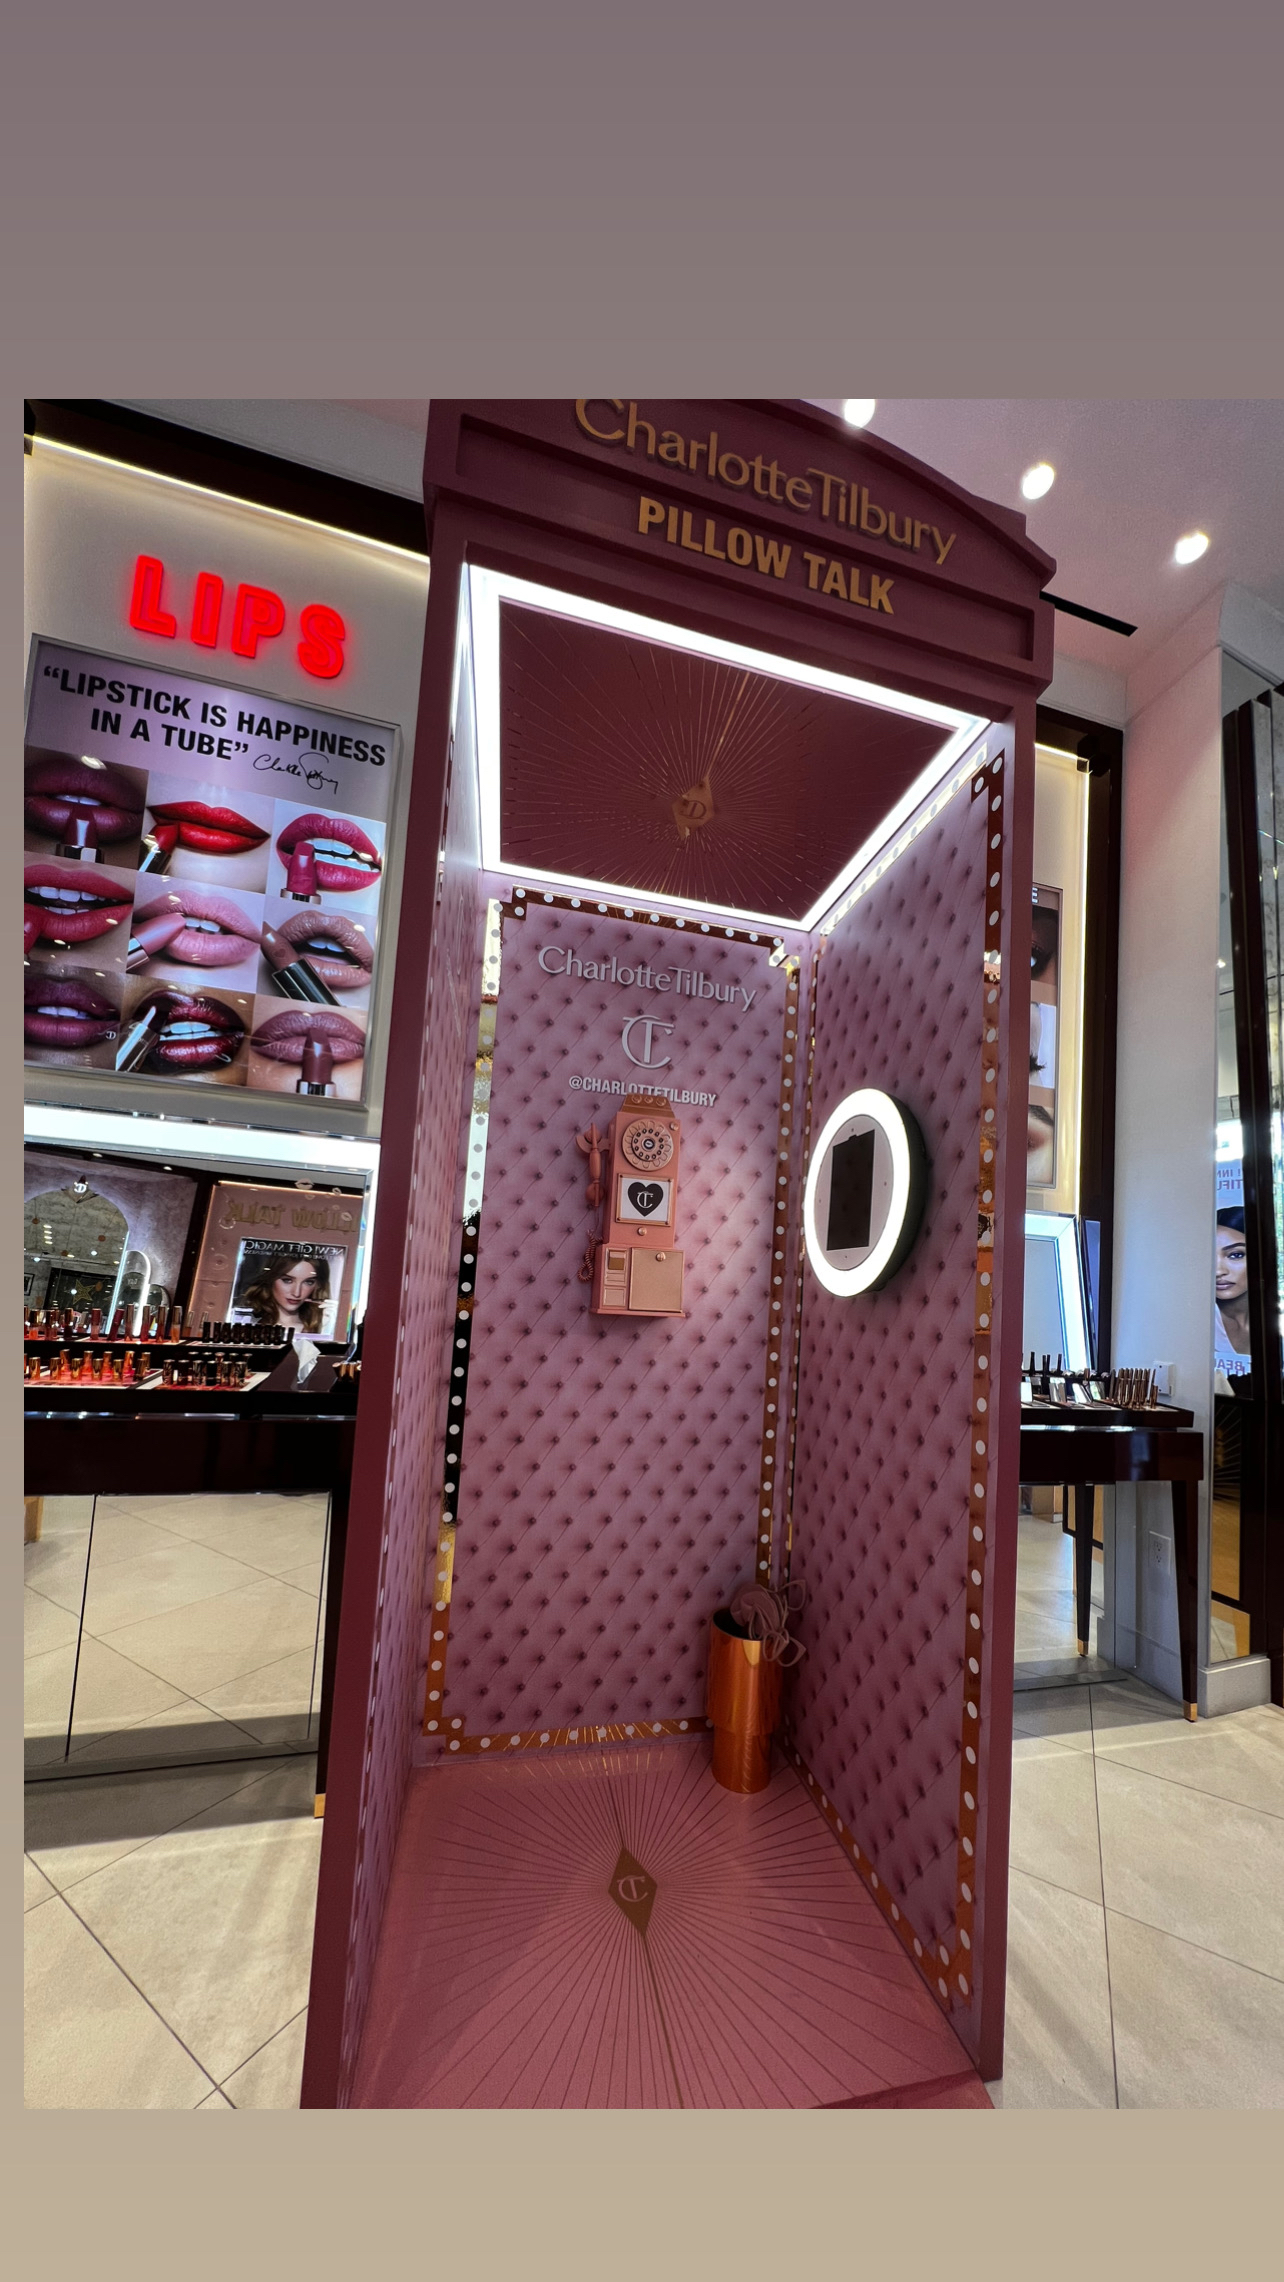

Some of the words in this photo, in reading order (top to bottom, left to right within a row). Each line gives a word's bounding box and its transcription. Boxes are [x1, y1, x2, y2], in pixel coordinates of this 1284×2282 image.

[638, 496, 792, 579] PILLOW
[803, 551, 895, 615] TALK
[130, 554, 346, 680] LIPS
[90, 708, 122, 735] IN
[130, 719, 151, 742] A
[201, 702, 227, 728] IS
[237, 711, 386, 767] HAPPINESS
[569, 1075, 717, 1107] @CHARLOTTETILBURY
